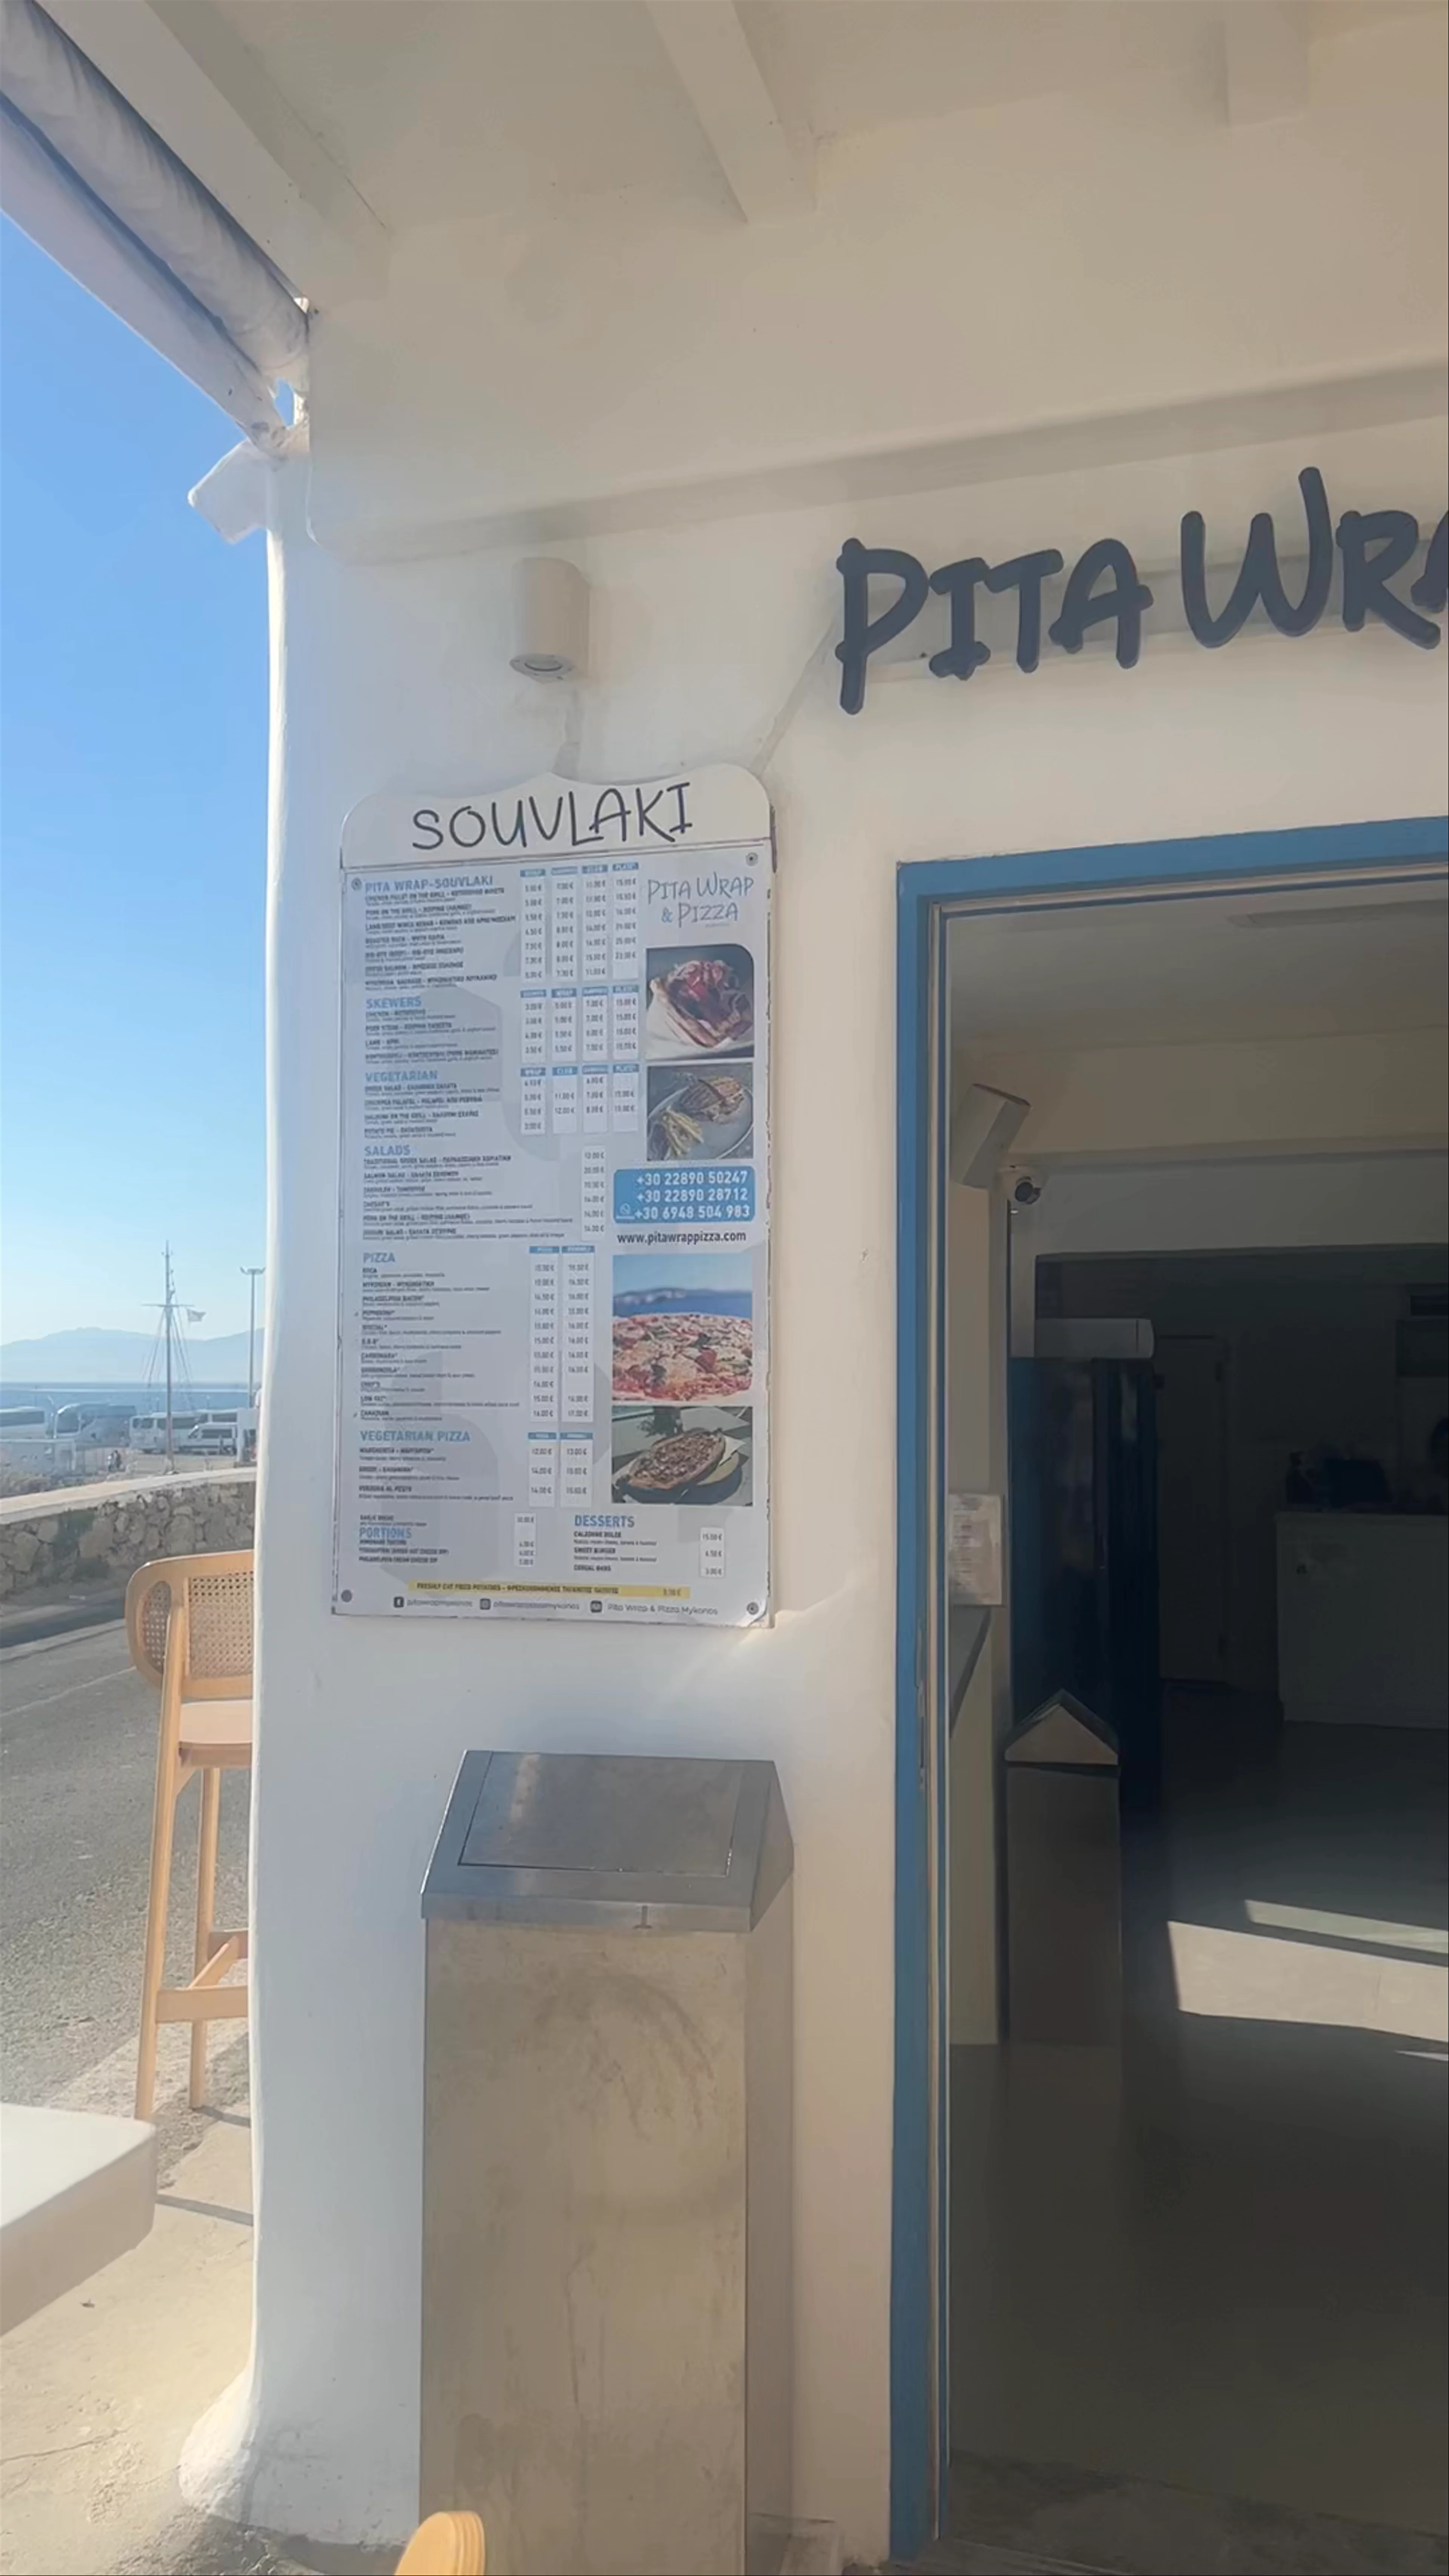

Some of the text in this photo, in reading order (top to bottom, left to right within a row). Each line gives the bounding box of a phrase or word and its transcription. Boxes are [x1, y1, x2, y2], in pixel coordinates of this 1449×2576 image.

[835, 537, 1154, 715] PITA
[412, 782, 694, 850] SOUVLAKI
[365, 875, 493, 893] PITA WRAP-SOUVLAKI
[648, 871, 754, 905] PITA WRAP
[662, 902, 738, 928] & PIZZA
[366, 996, 422, 1009] SKEWERS
[365, 1070, 438, 1082] VEGETARIAN
[365, 1145, 411, 1156] SALADS
[636, 1170, 748, 1186] +30 22890 50247
[637, 1188, 748, 1202] +30 22890 28712
[634, 1205, 750, 1219] +30 6948 504 983
[617, 1230, 746, 1245] www.pitawrappizza.com
[363, 1252, 395, 1263] PIZZA
[360, 1431, 471, 1442] VEGETARIAN PIZZA
[575, 1515, 635, 1527] DESSERTS
[359, 1527, 412, 1539] PORTIONS
